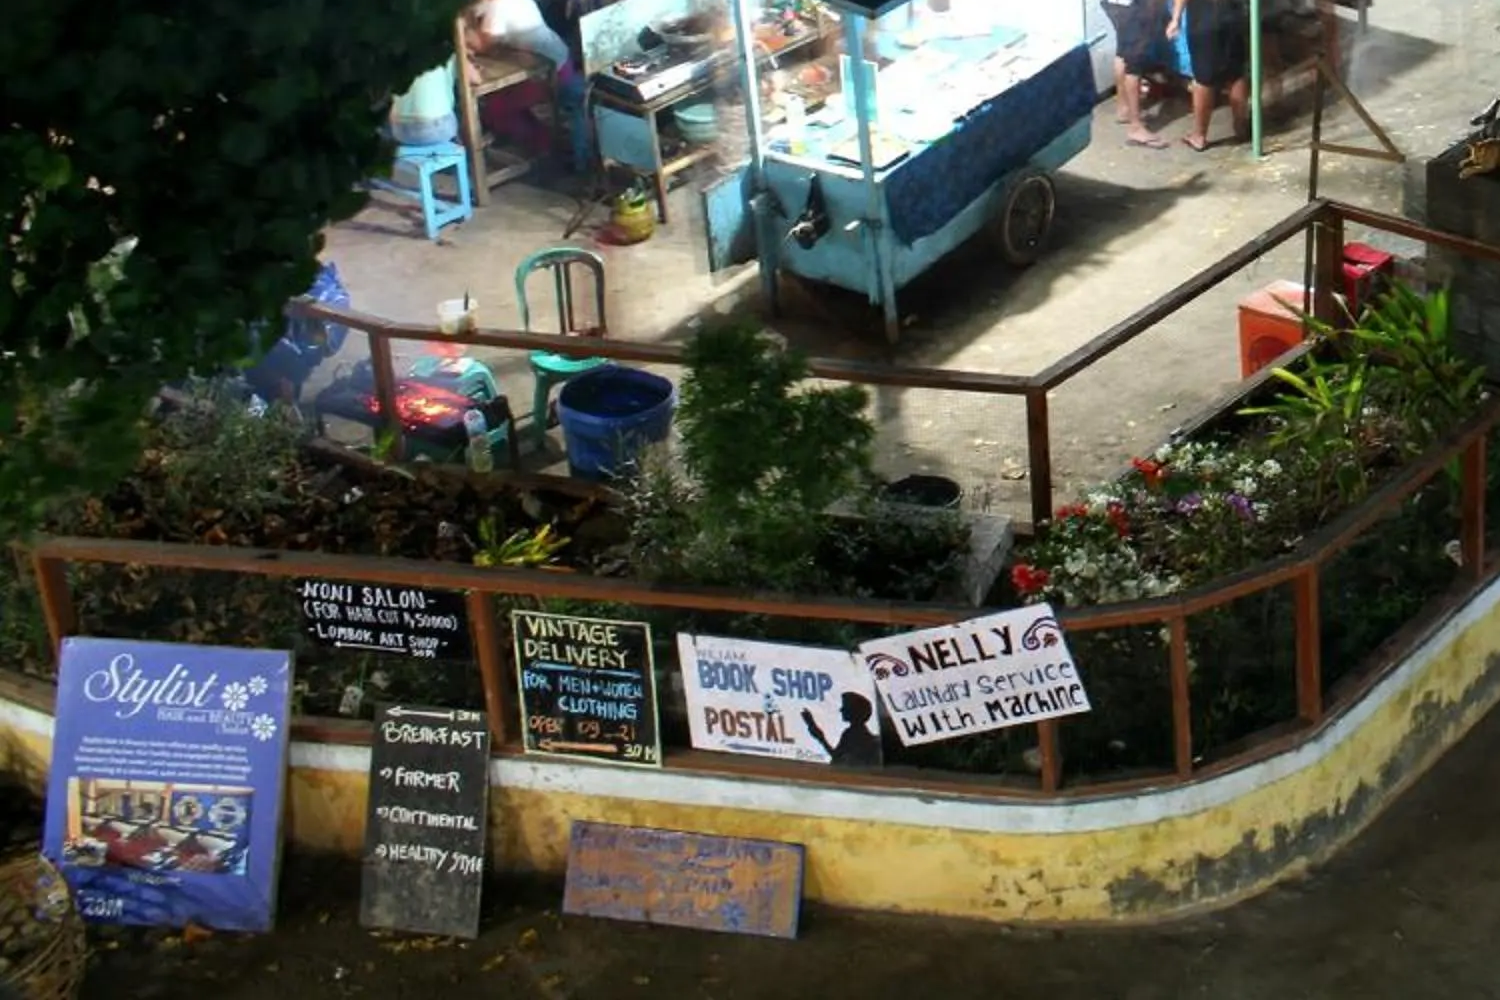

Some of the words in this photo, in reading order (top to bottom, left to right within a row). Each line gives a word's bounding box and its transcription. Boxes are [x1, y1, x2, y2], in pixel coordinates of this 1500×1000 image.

[377, 608, 399, 625] CUT
[379, 632, 404, 648] ART
[525, 615, 620, 646] VINTAGE
[523, 639, 628, 669] DELIVERY
[907, 625, 1013, 674] NELLY
[84, 653, 219, 719] Stylist
[523, 669, 552, 690] FOR
[697, 659, 759, 693] BOOK
[770, 667, 833, 702] SHOP
[557, 695, 638, 720] CLOTHING
[382, 720, 486, 749] BREAKFAST
[704, 706, 796, 744] POSTAL
[394, 766, 461, 792] FARMER
[389, 806, 479, 830] CONTINENTAL
[388, 844, 449, 870] HEALTHY
